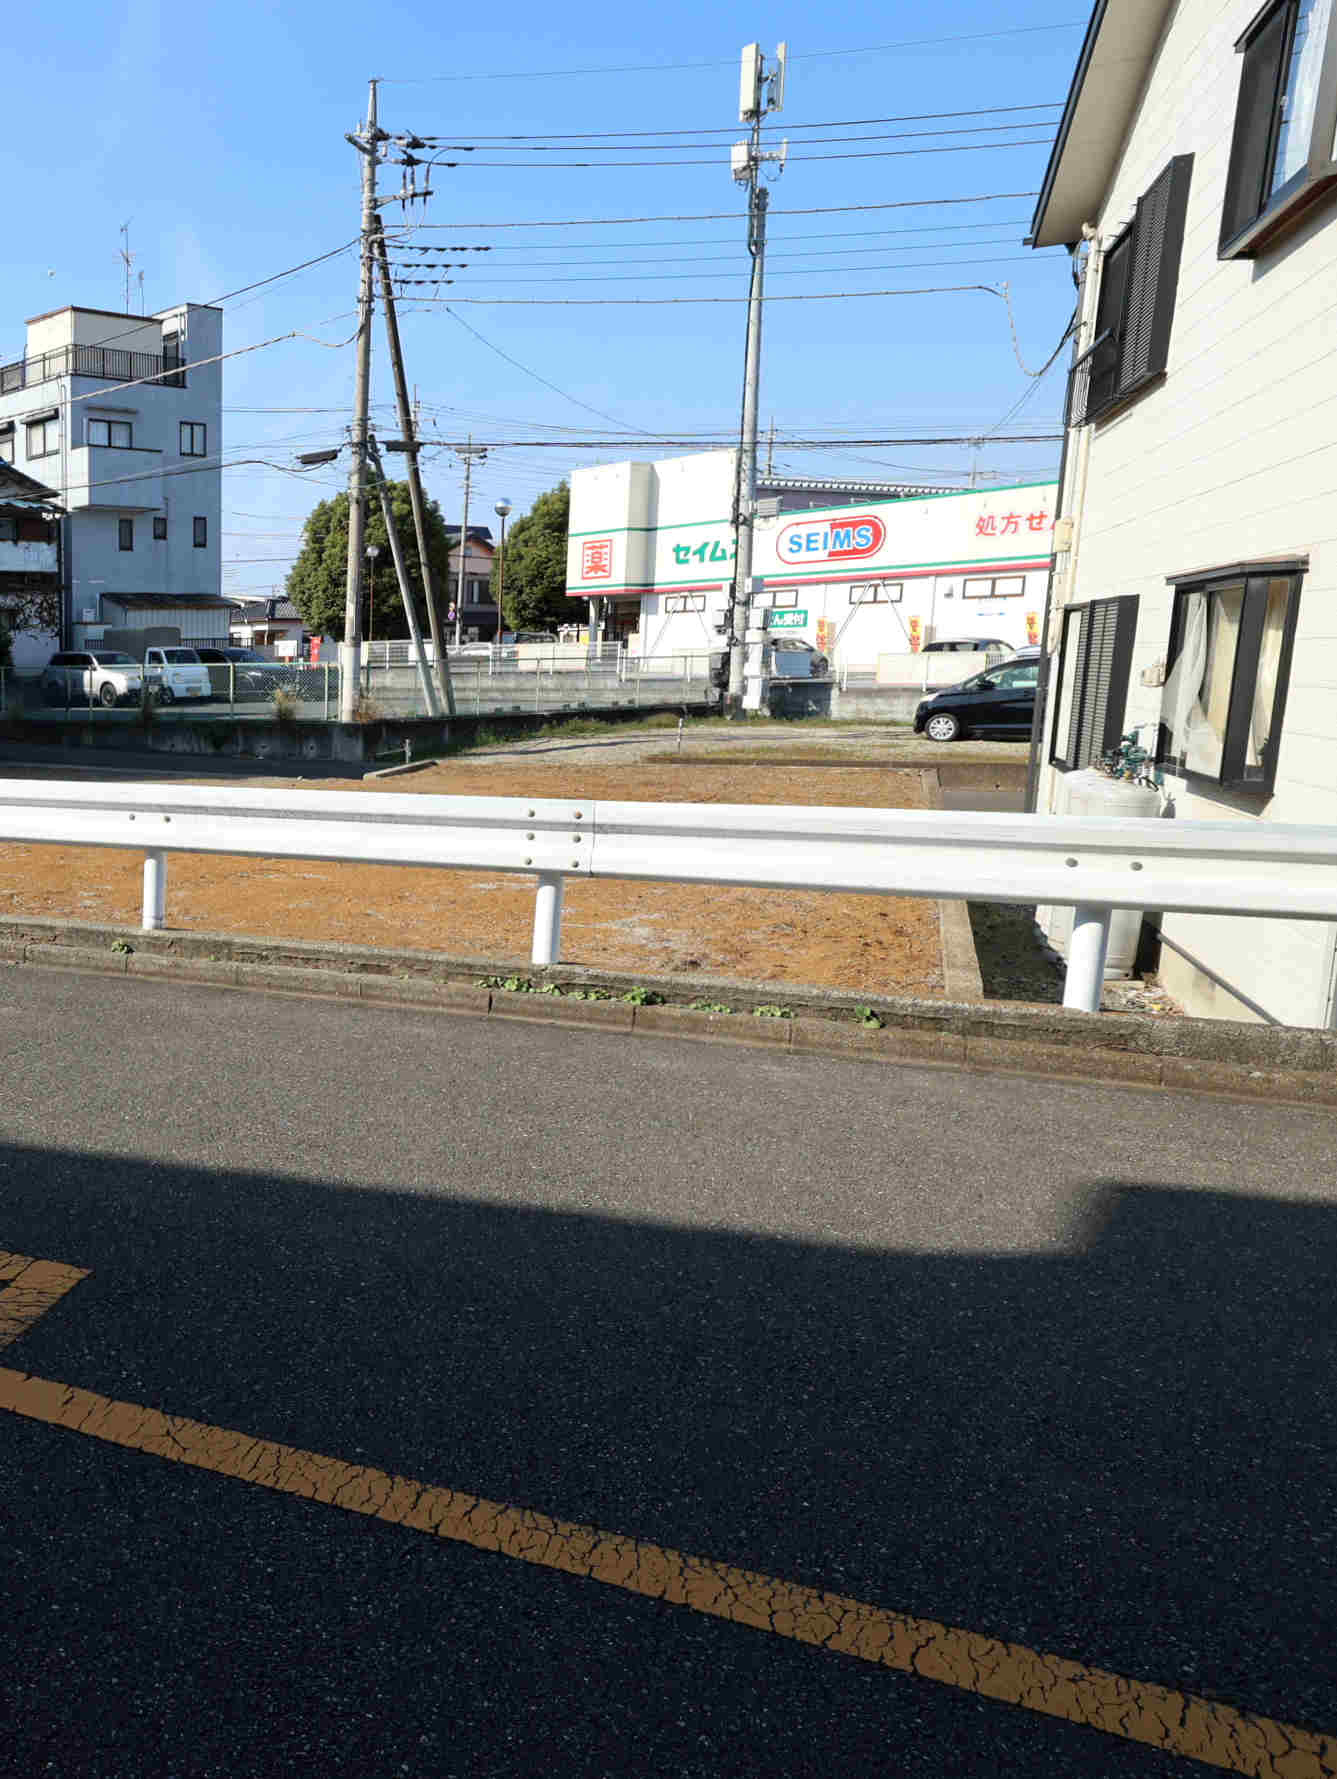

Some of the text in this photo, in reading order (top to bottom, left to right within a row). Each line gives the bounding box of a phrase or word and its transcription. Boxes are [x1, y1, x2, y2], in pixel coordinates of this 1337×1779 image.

[976, 511, 1055, 536] 処方せ
[788, 527, 872, 553] SEIMS
[584, 544, 609, 574] 薬
